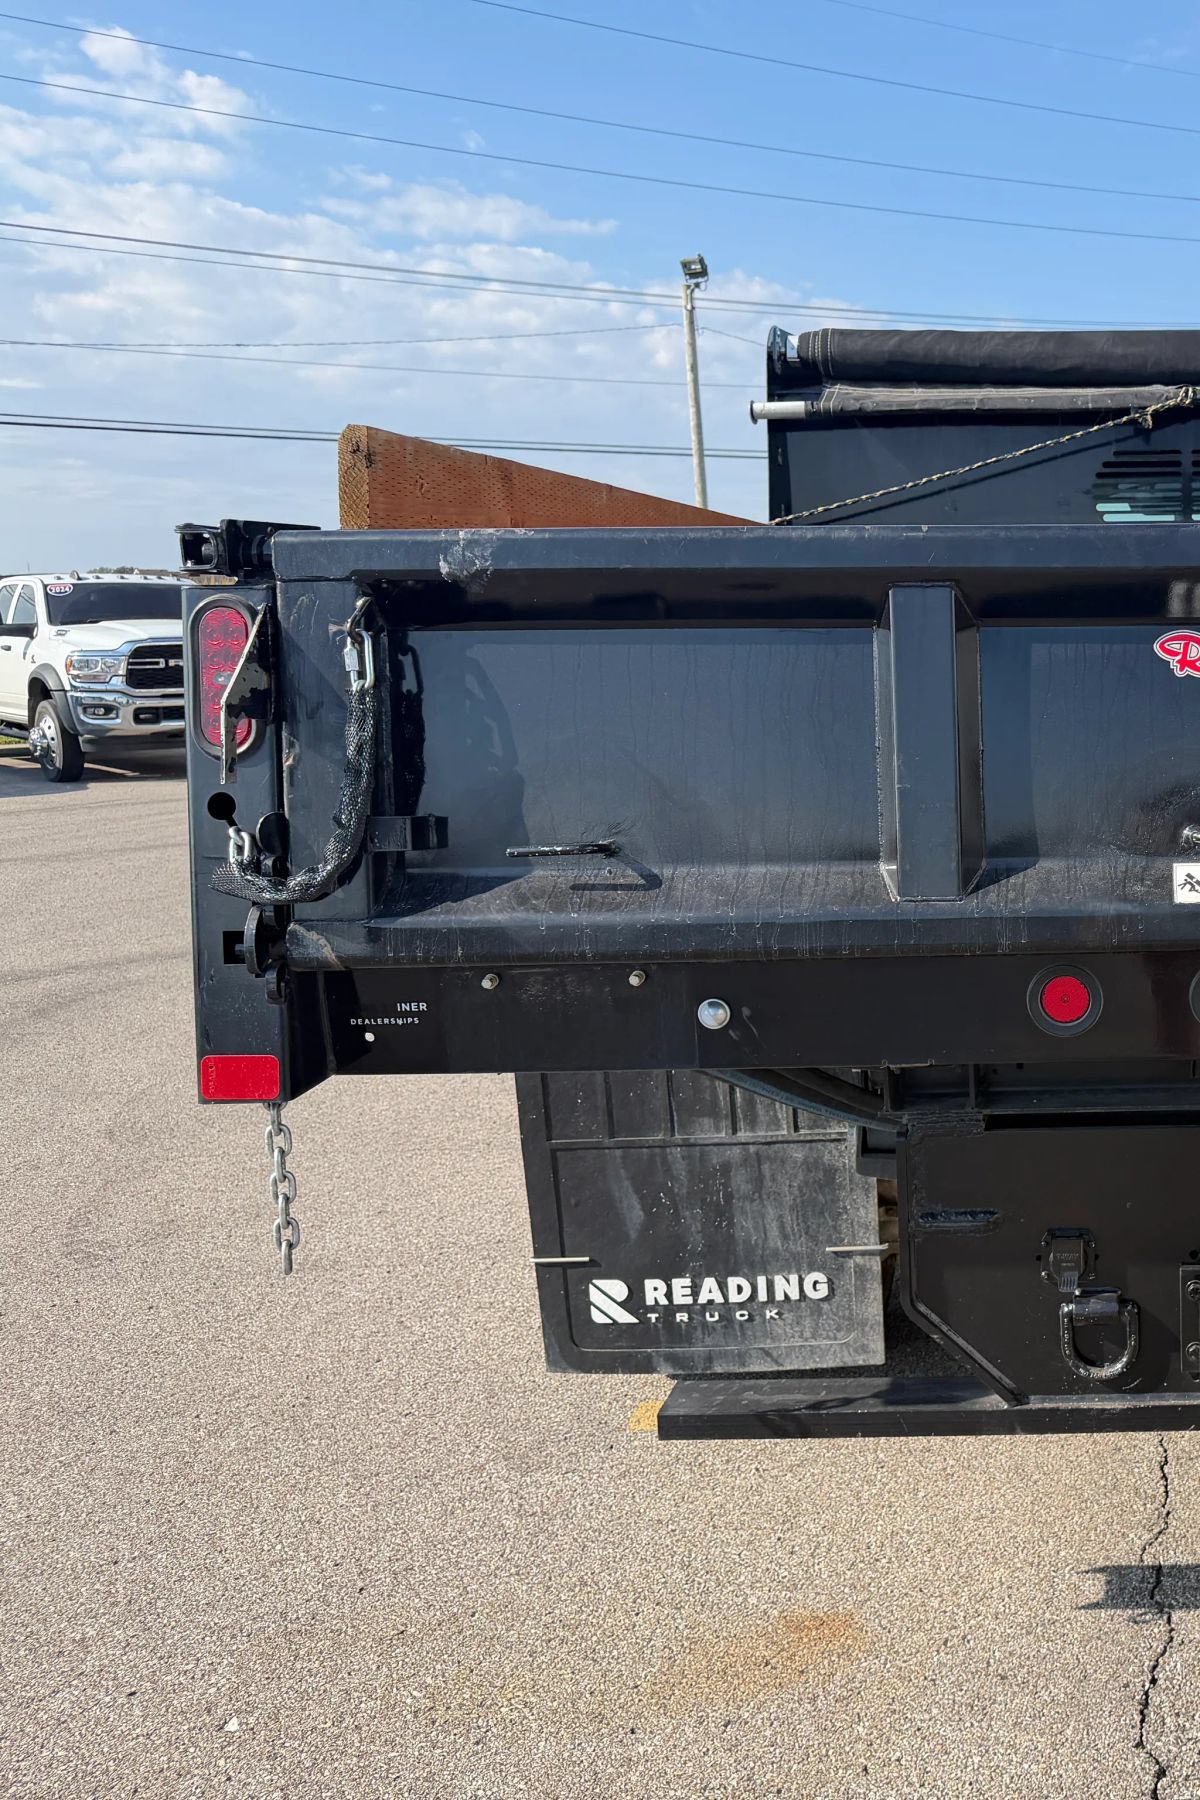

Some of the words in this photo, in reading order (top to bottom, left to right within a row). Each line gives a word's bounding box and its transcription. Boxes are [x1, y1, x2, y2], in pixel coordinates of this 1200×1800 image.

[50, 585, 70, 593] 2024
[350, 1017, 420, 1025] DEALERSHIPS
[644, 1271, 830, 1306] READING
[647, 1309, 780, 1323] TRUCK
